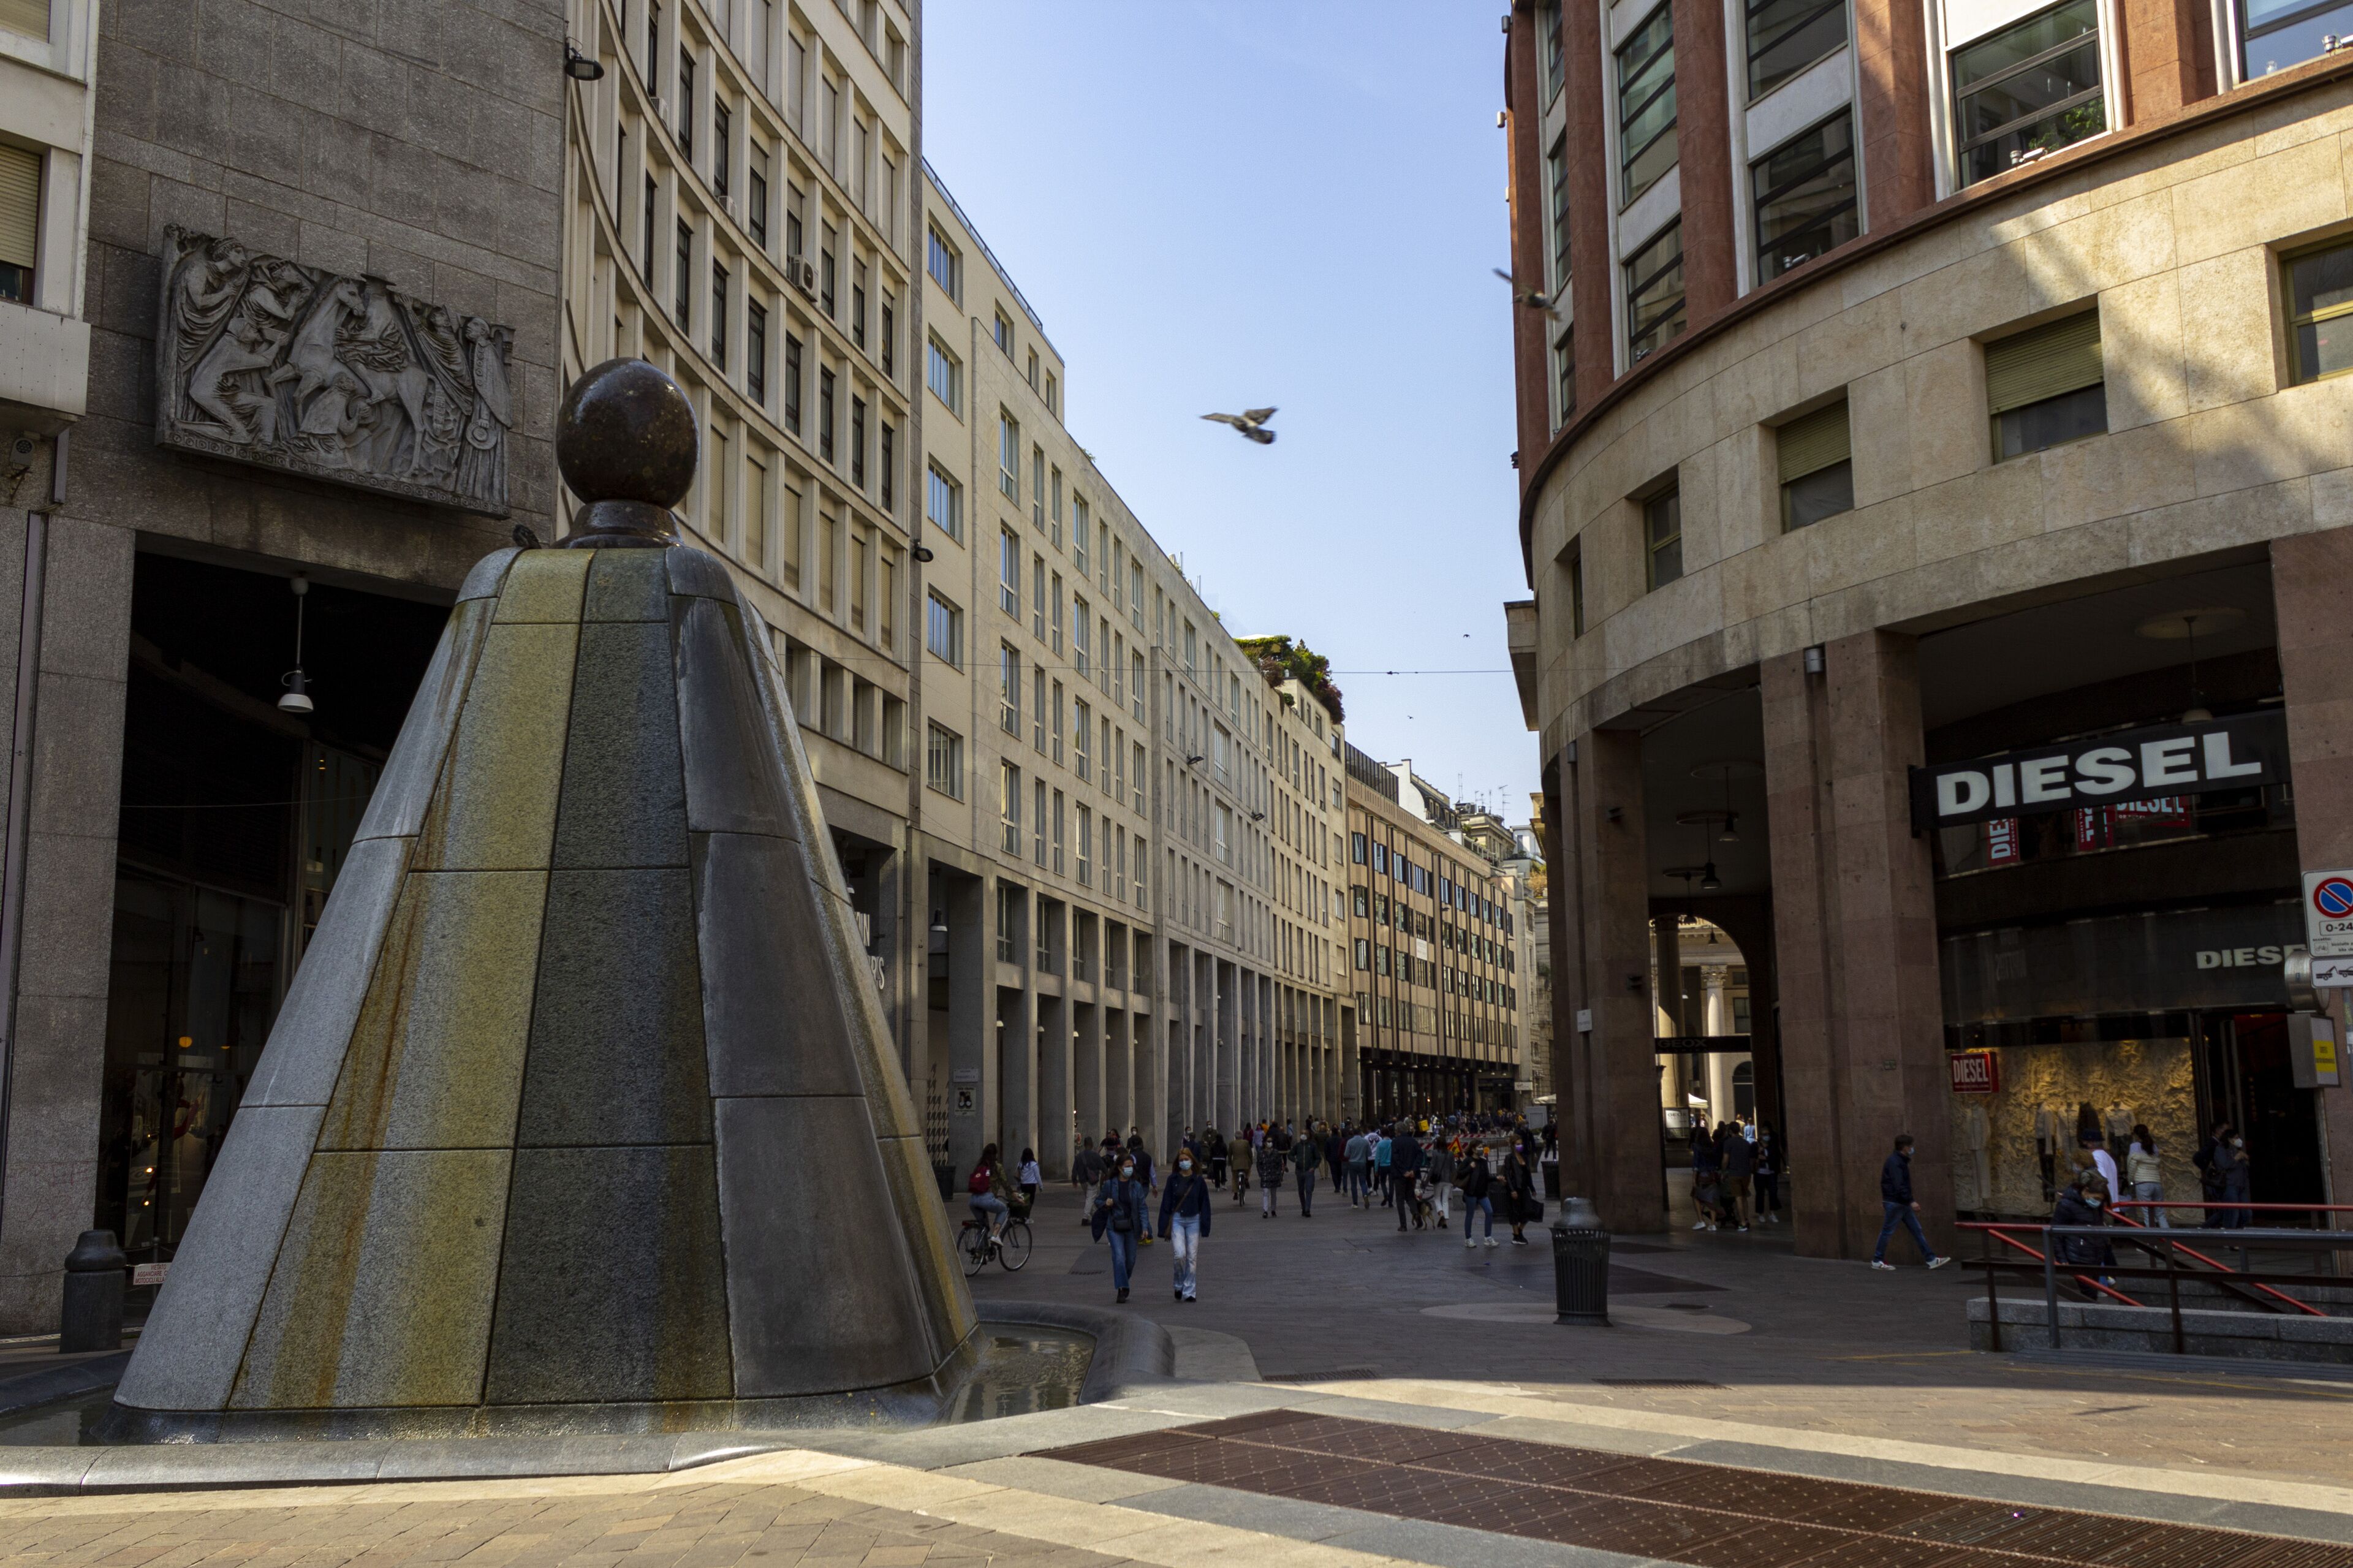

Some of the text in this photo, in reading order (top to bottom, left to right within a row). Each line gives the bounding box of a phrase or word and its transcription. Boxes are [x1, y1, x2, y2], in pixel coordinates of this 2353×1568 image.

[1936, 732, 2262, 816] DIESEL
[2116, 796, 2184, 814] SEL
[2326, 922, 2353, 932] 0-24
[1658, 1039, 1707, 1048] GEOX
[1953, 1058, 1989, 1083] DIESEL
